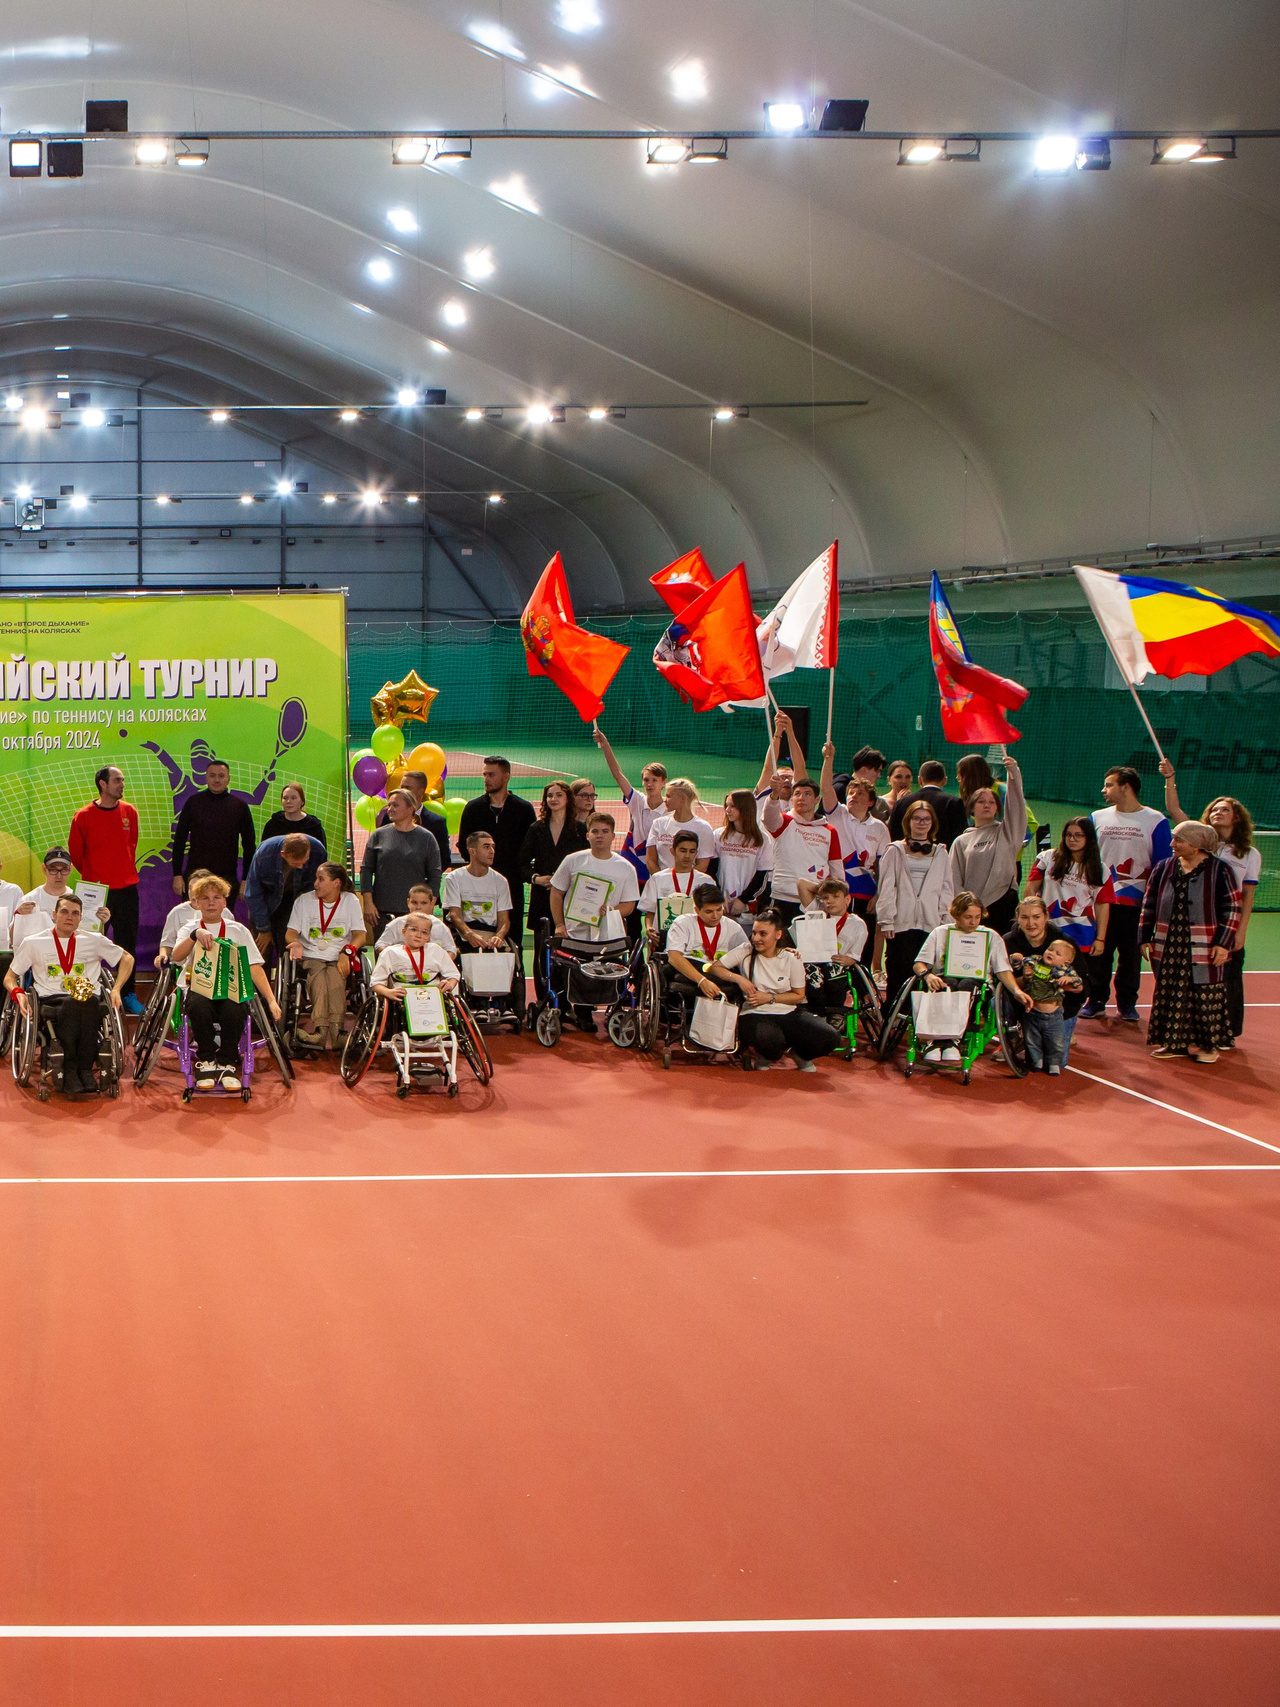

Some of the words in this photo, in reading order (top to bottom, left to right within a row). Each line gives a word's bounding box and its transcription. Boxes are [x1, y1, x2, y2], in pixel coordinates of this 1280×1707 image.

[138, 657, 278, 700] ТУРНИР
[32, 710, 50, 724] по
[54, 708, 114, 728] теннису
[117, 709, 135, 723] на
[139, 708, 207, 723] колясках
[2, 731, 62, 755] октября
[66, 730, 101, 750] 2024
